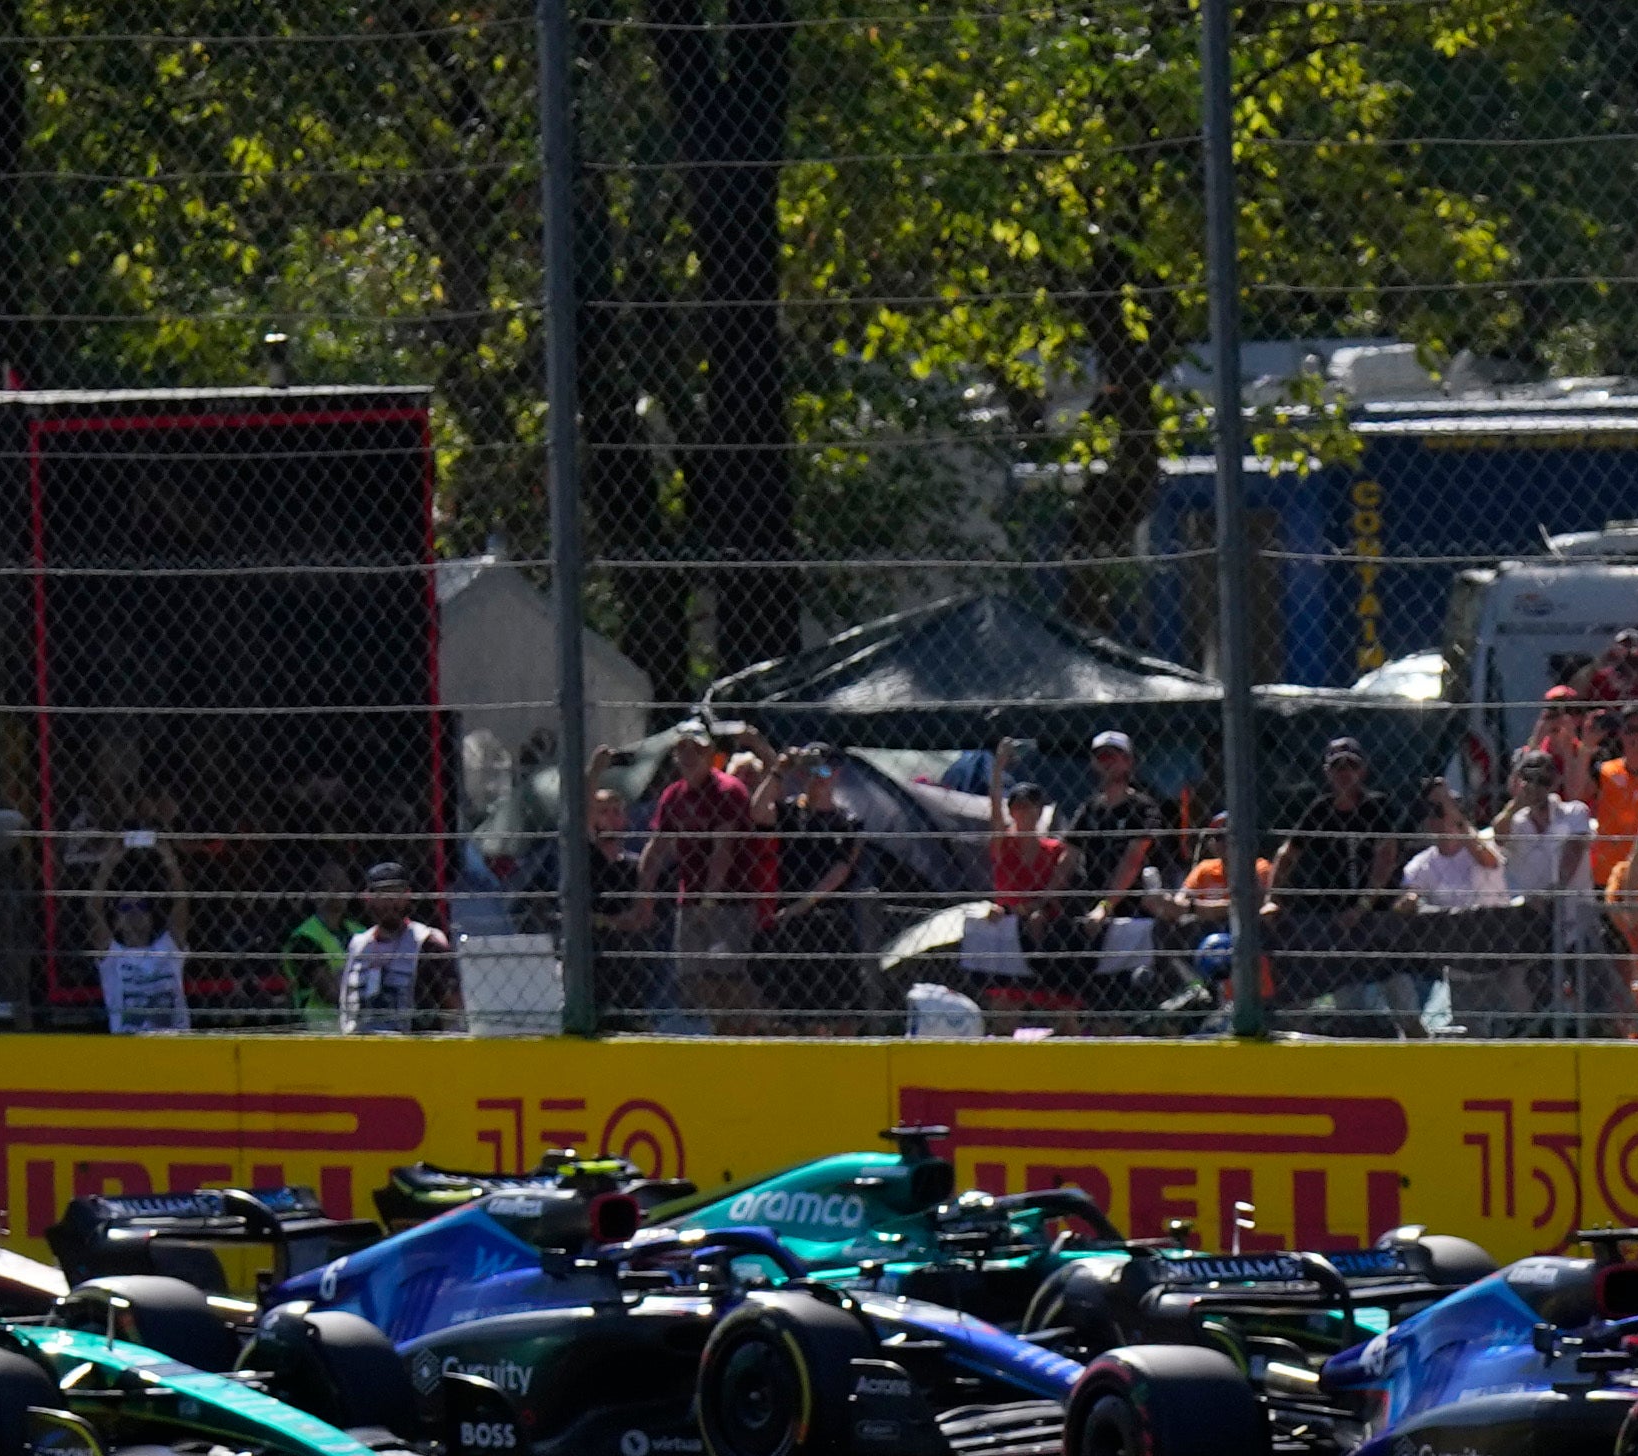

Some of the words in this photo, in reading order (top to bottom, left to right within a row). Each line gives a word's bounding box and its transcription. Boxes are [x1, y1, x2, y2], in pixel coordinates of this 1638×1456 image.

[728, 1190, 864, 1228] aramco
[1167, 1253, 1304, 1281] WILLIAMS
[459, 1422, 517, 1449] BOSS
